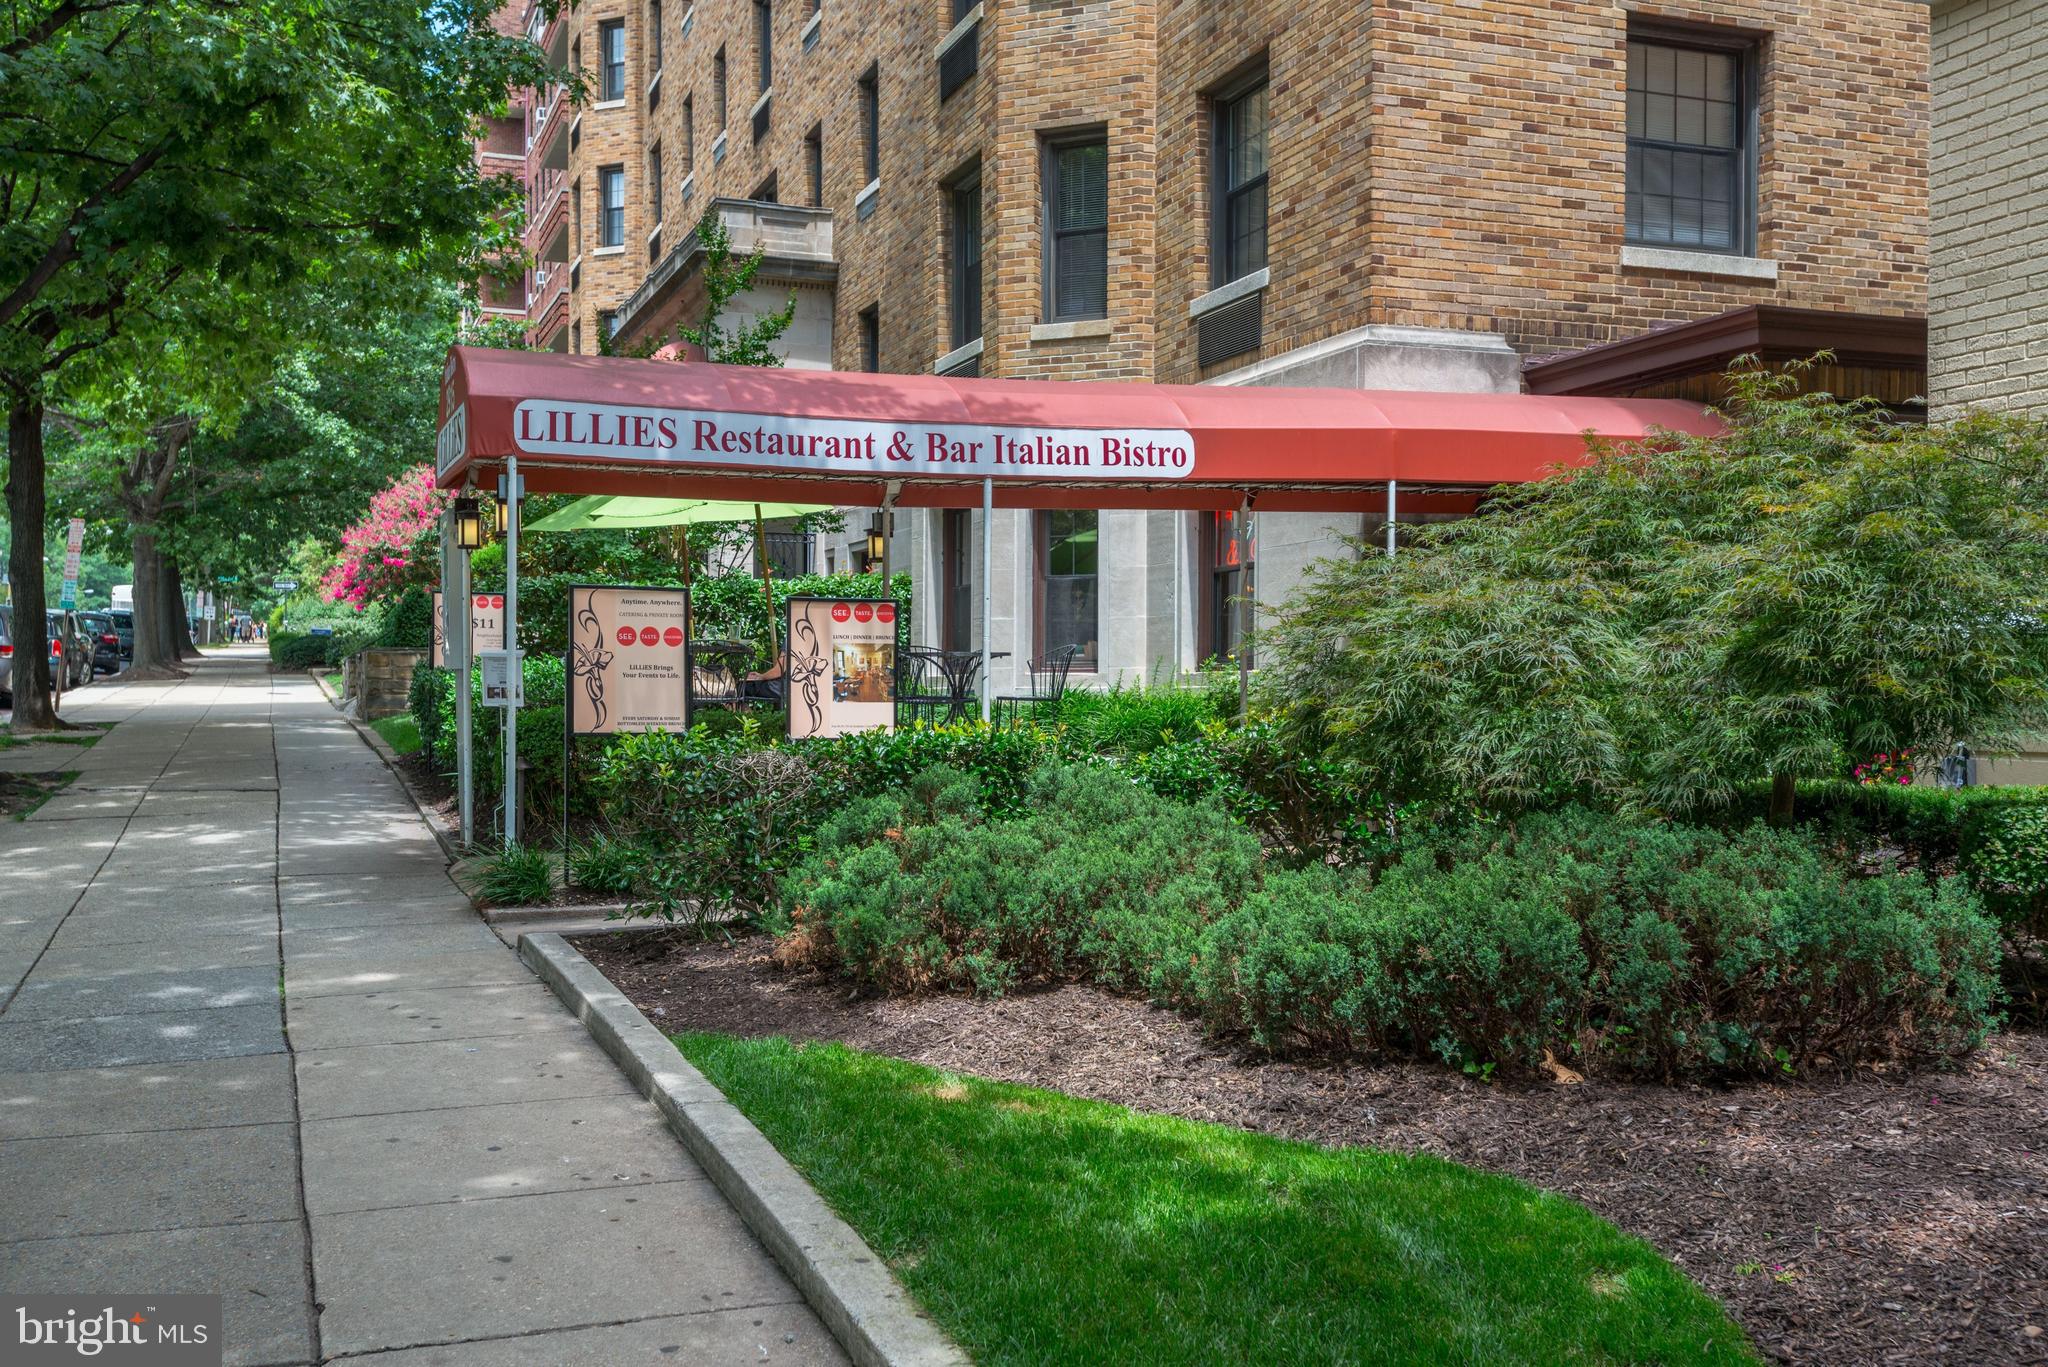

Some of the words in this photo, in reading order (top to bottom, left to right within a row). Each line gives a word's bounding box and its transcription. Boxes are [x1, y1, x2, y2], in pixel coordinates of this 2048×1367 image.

[519, 408, 678, 449] LILLIES
[691, 419, 876, 461] Restaurant
[886, 430, 915, 462] &
[925, 432, 983, 464] Bar
[993, 434, 1091, 467] Italian
[1101, 437, 1187, 468] Bistro
[621, 598, 648, 606] Anytime.
